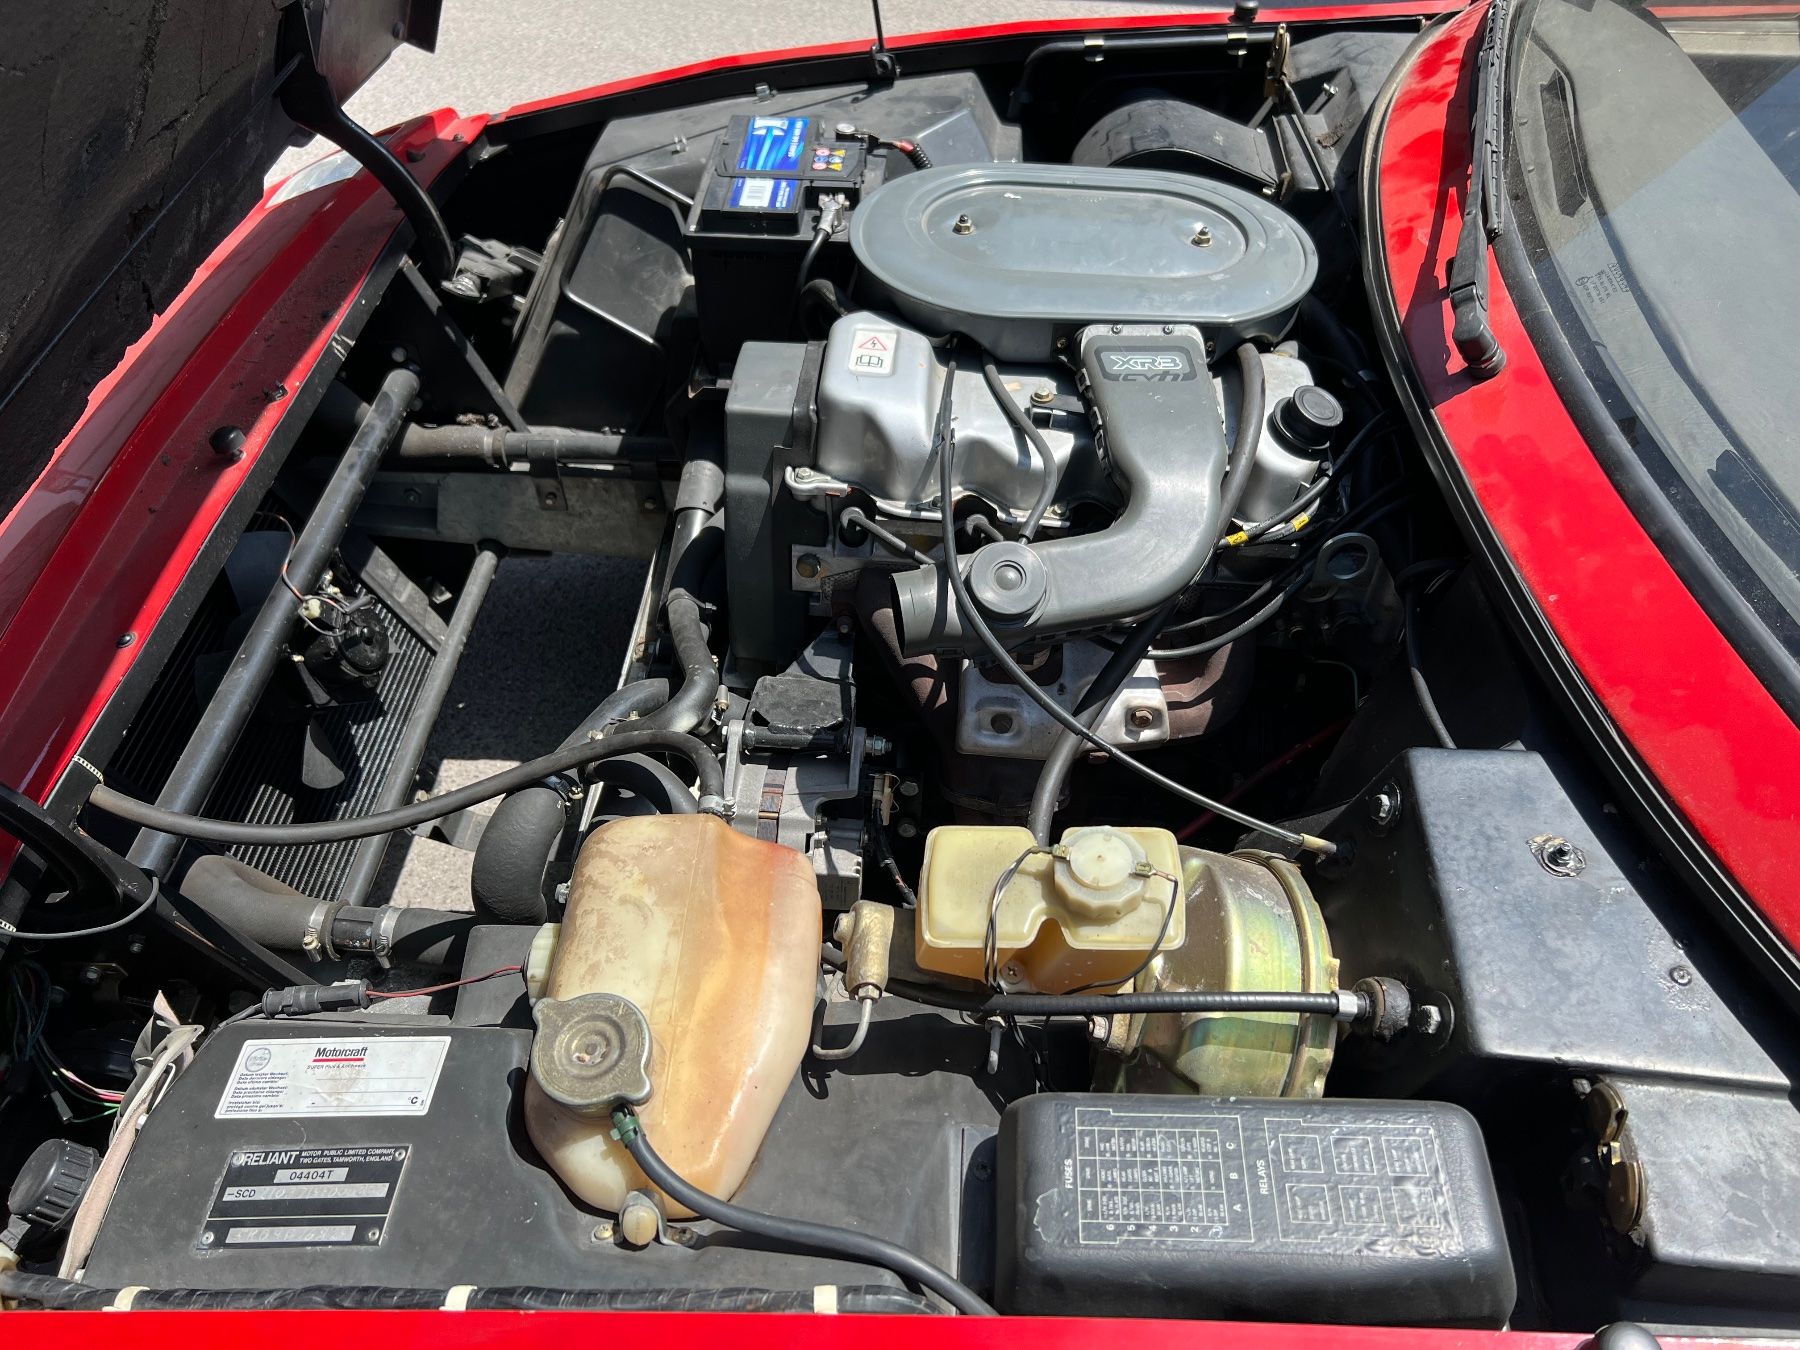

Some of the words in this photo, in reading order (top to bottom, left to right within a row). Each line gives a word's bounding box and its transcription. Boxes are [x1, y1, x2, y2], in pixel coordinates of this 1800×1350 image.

[1110, 355, 1182, 370] XR3
[314, 1046, 368, 1058] Motorcraft
[244, 1152, 299, 1166] RELIANT
[290, 1170, 334, 1180] 04404T
[1064, 1159, 1073, 1188] FUSES
[1256, 1159, 1269, 1194] RELAYS
